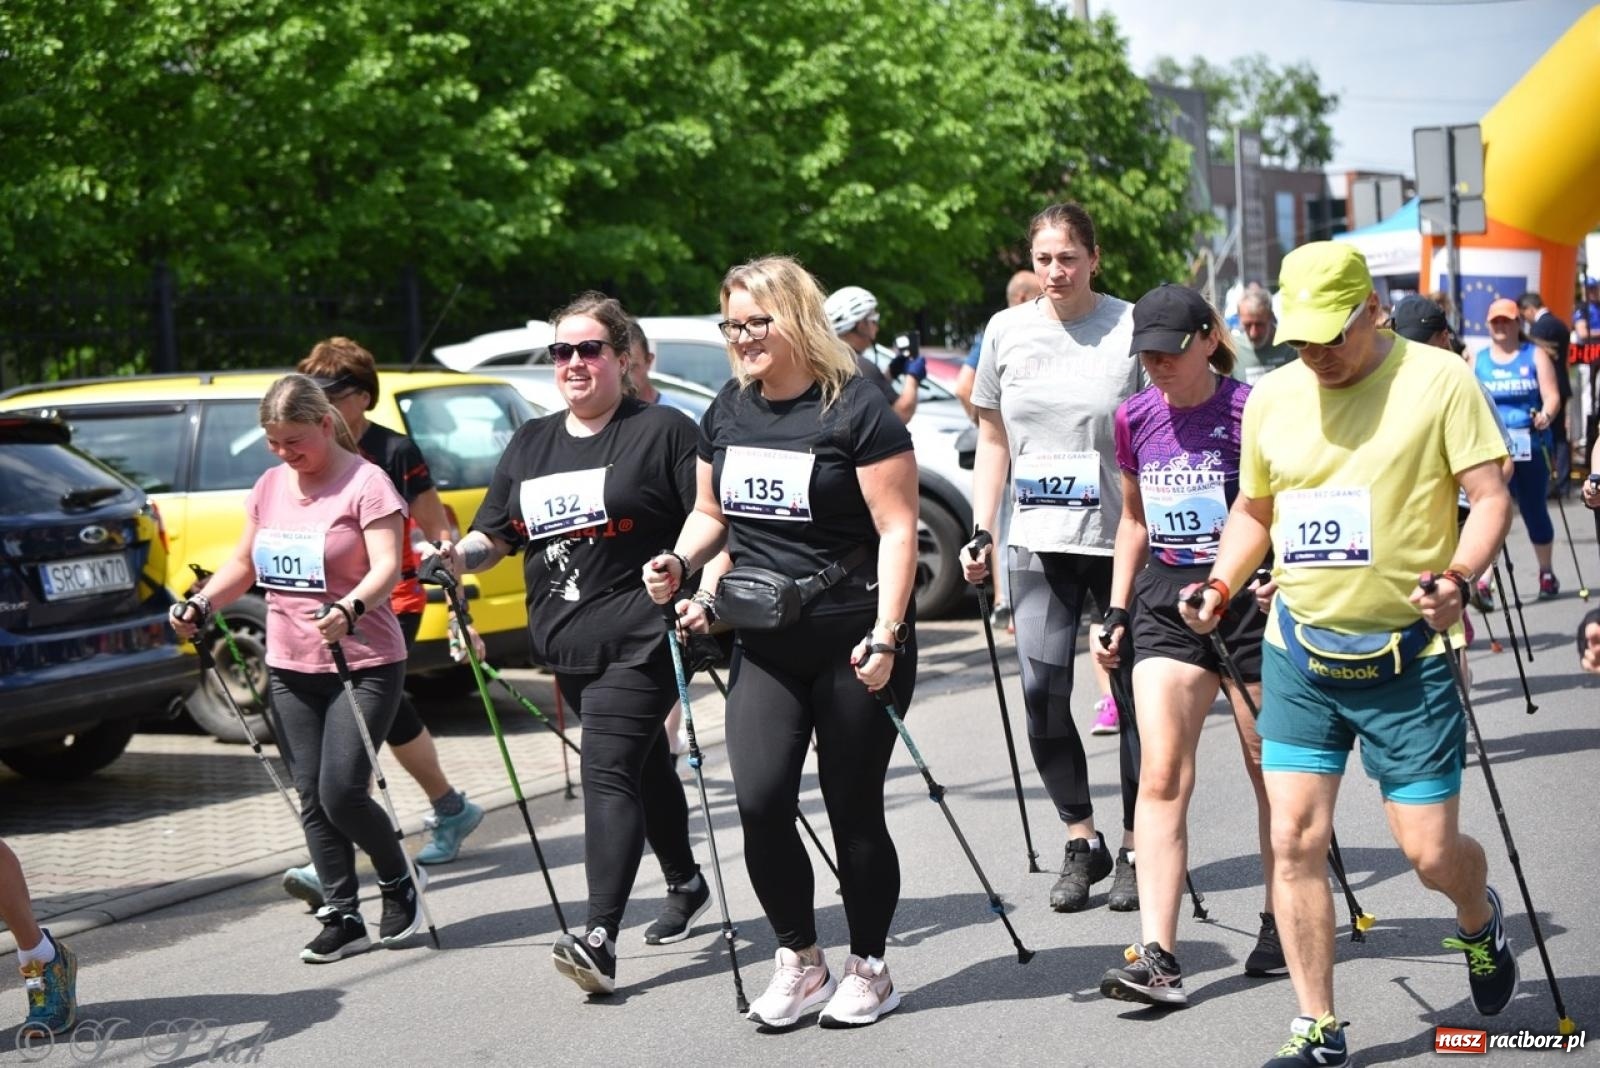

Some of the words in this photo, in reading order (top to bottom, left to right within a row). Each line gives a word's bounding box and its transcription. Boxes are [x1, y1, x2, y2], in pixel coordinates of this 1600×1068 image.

[744, 477, 785, 502] 135
[1038, 476, 1076, 495] 127
[544, 494, 581, 518] 132
[1165, 510, 1202, 531] 113
[1298, 520, 1341, 545] 129
[52, 563, 86, 592] SRC
[87, 557, 128, 587] XW70
[272, 555, 302, 575] 101
[1308, 657, 1379, 680] Reebok
